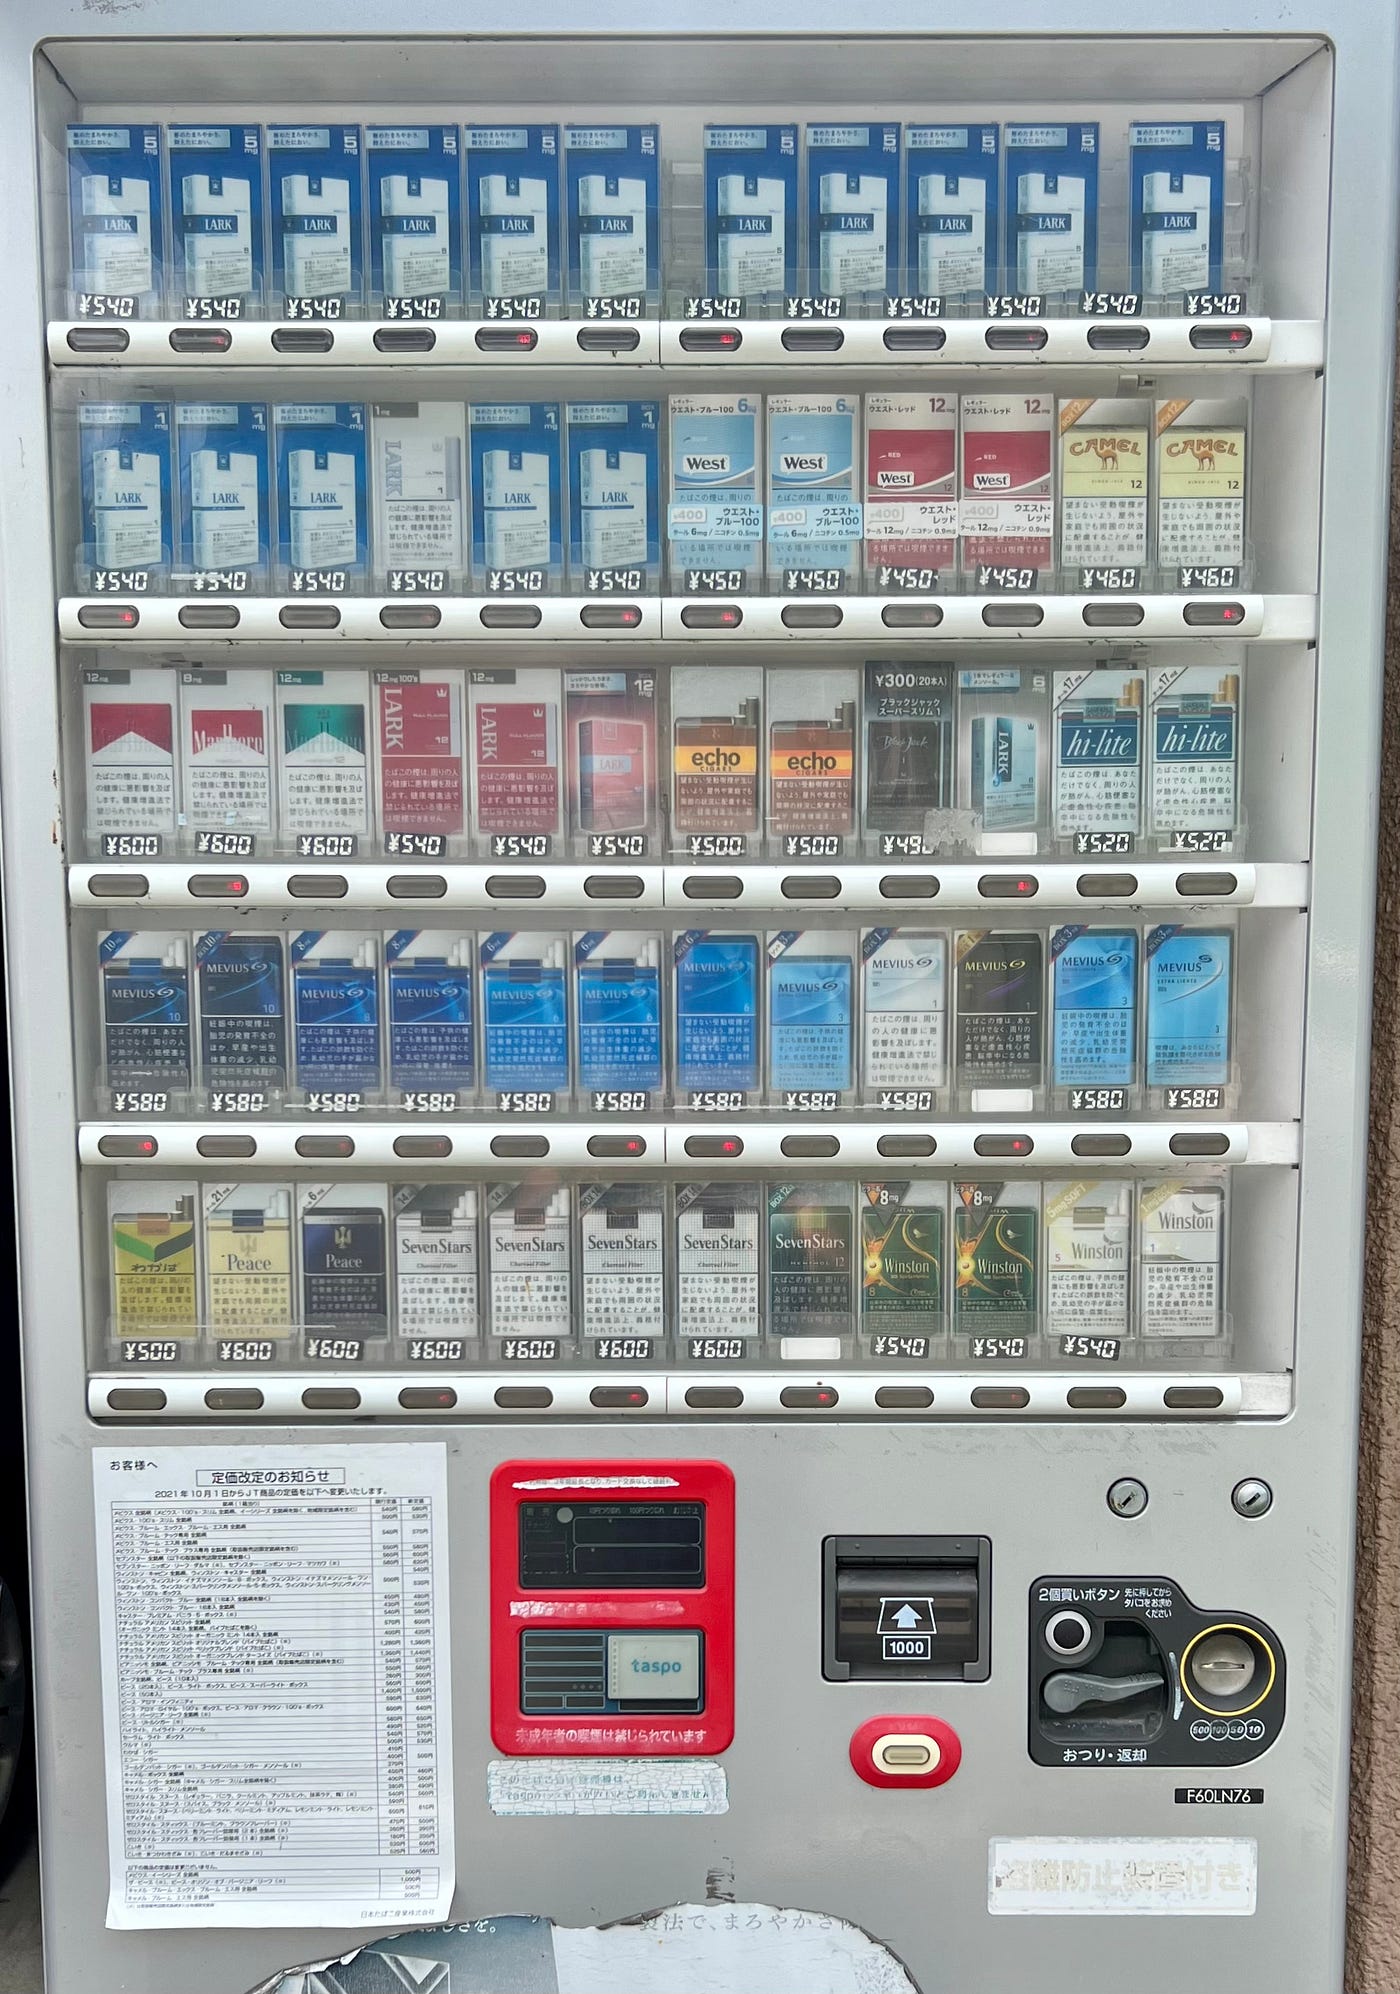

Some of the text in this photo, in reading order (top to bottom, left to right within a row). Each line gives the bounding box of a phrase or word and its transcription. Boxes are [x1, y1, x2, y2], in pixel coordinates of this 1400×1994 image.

[1206, 133, 1221, 145] 5
[104, 220, 132, 231] LARK
[205, 219, 232, 230] LARK
[303, 220, 332, 231] LARK
[402, 220, 430, 231] LARK
[501, 220, 529, 231] LARK
[600, 220, 628, 231] LARK
[739, 219, 767, 231] LARK
[840, 217, 868, 229] LARK
[939, 218, 967, 230] LARK
[1038, 217, 1066, 229] LARK
[1163, 216, 1191, 228] LARK
[79, 294, 134, 318] ¥540
[186, 299, 241, 319] ¥540
[287, 299, 340, 319] ¥540
[387, 298, 440, 319] ¥540
[487, 298, 541, 319] ¥540
[587, 298, 640, 319] ¥540
[687, 298, 741, 318] ¥540
[787, 298, 841, 318] ¥540
[887, 298, 940, 318] ¥540
[987, 296, 1041, 317] ¥540
[1082, 293, 1138, 315] ¥540
[1187, 294, 1240, 315] ¥540
[1069, 438, 1142, 457] CAMEL
[1166, 439, 1238, 457] CAMEL
[385, 440, 402, 497] LARK
[686, 457, 727, 470] West
[784, 457, 824, 470] West
[880, 474, 911, 484] West
[977, 476, 1008, 486] West
[1131, 480, 1142, 488] 12
[1227, 480, 1239, 489] 12
[115, 493, 142, 503] LARK
[212, 493, 240, 504] LARK
[310, 493, 337, 503] LARK
[504, 493, 531, 504] LARK
[601, 492, 628, 502] LARK
[715, 517, 760, 526] ブルー100
[815, 517, 859, 526] ブルー100
[932, 516, 956, 524] レッド
[95, 572, 148, 591] ¥540
[194, 572, 247, 591] ¥540
[292, 572, 346, 591] ¥540
[391, 572, 444, 591] ¥540
[489, 572, 542, 591] ¥540
[588, 571, 641, 591] ¥540
[689, 571, 741, 590] ¥450
[787, 571, 840, 590] ¥450
[879, 567, 933, 588] ¥450
[979, 567, 1033, 588] ¥450
[1082, 568, 1136, 588] ¥460
[1181, 568, 1234, 587] ¥460
[879, 698, 940, 707] ブラックジャック
[384, 687, 404, 749] LARK
[879, 707, 930, 717] スーパースリム
[480, 707, 498, 760] LARK
[1067, 728, 1132, 757] hi-lite
[1162, 724, 1227, 752] hi-lite
[691, 748, 740, 766] echo
[787, 752, 837, 770] echo
[998, 731, 1008, 775] LARK
[107, 837, 158, 856] ¥600
[199, 833, 251, 855] ¥600
[300, 837, 353, 856] ¥600
[388, 833, 442, 855] ¥540
[495, 836, 547, 855] ¥540
[592, 836, 644, 855] ¥540
[690, 836, 743, 856] ¥500
[786, 836, 839, 855] ¥500
[1078, 833, 1130, 852] ¥520
[1175, 831, 1227, 851] ¥520
[206, 963, 249, 973] MEVIUS
[684, 963, 726, 973] MEVIUS
[872, 959, 914, 969] MEVIUS
[965, 960, 1008, 971] MEVIUS
[1062, 956, 1105, 966] MEVIUS
[1157, 961, 1202, 972] MEVIUS
[112, 989, 155, 998] MEVIUS
[302, 989, 345, 999] MEVIUS
[396, 988, 440, 998] MEVIUS
[491, 990, 534, 1000] MEVIUS
[585, 989, 628, 999] MEVIUS
[778, 982, 820, 992] MEVIUS
[114, 1093, 167, 1112] ¥580
[211, 1093, 264, 1112] ¥580
[308, 1094, 360, 1112] ¥580
[404, 1094, 456, 1112] ¥580
[500, 1093, 551, 1112] ¥580
[595, 1092, 646, 1111] ¥580
[691, 1093, 743, 1111] ¥580
[786, 1093, 837, 1111] ¥580
[880, 1092, 932, 1111] ¥580
[1072, 1090, 1124, 1109] ¥580
[1168, 1089, 1219, 1108] ¥580
[1159, 1212, 1213, 1230] Winston
[1072, 1242, 1123, 1260] Winston
[131, 1264, 177, 1272] わかば
[227, 1254, 271, 1271] Peace
[326, 1254, 362, 1268] Peace
[885, 1257, 930, 1273] Winston
[978, 1258, 1022, 1274] Winston
[125, 1343, 177, 1360] ¥500
[220, 1343, 272, 1361] ¥600
[307, 1339, 360, 1360] ¥600
[411, 1341, 462, 1359] ¥600
[505, 1341, 556, 1359] ¥600
[598, 1340, 649, 1358] ¥600
[691, 1340, 742, 1358] ¥600
[875, 1337, 927, 1357] ¥540
[973, 1339, 1024, 1357] ¥540
[1064, 1336, 1116, 1358] ¥540
[109, 1460, 158, 1471] お客様へ
[211, 1471, 330, 1485] 定価改定のお知らせ
[1039, 1588, 1120, 1602] 2個買いボタン
[1124, 1587, 1172, 1597] 先に押してから
[1124, 1599, 1172, 1608] タバコをお求め
[1145, 1609, 1172, 1618] ください
[889, 1641, 924, 1654] 1000
[632, 1659, 682, 1676] taspo
[516, 1728, 707, 1744] 未成年者の喫煙は禁じられています
[1192, 1725, 1209, 1734] 500
[1230, 1725, 1244, 1734] 50
[1248, 1725, 1260, 1734] 10
[1063, 1749, 1147, 1762] おつり・返却
[1187, 1789, 1251, 1803] F60LN76
